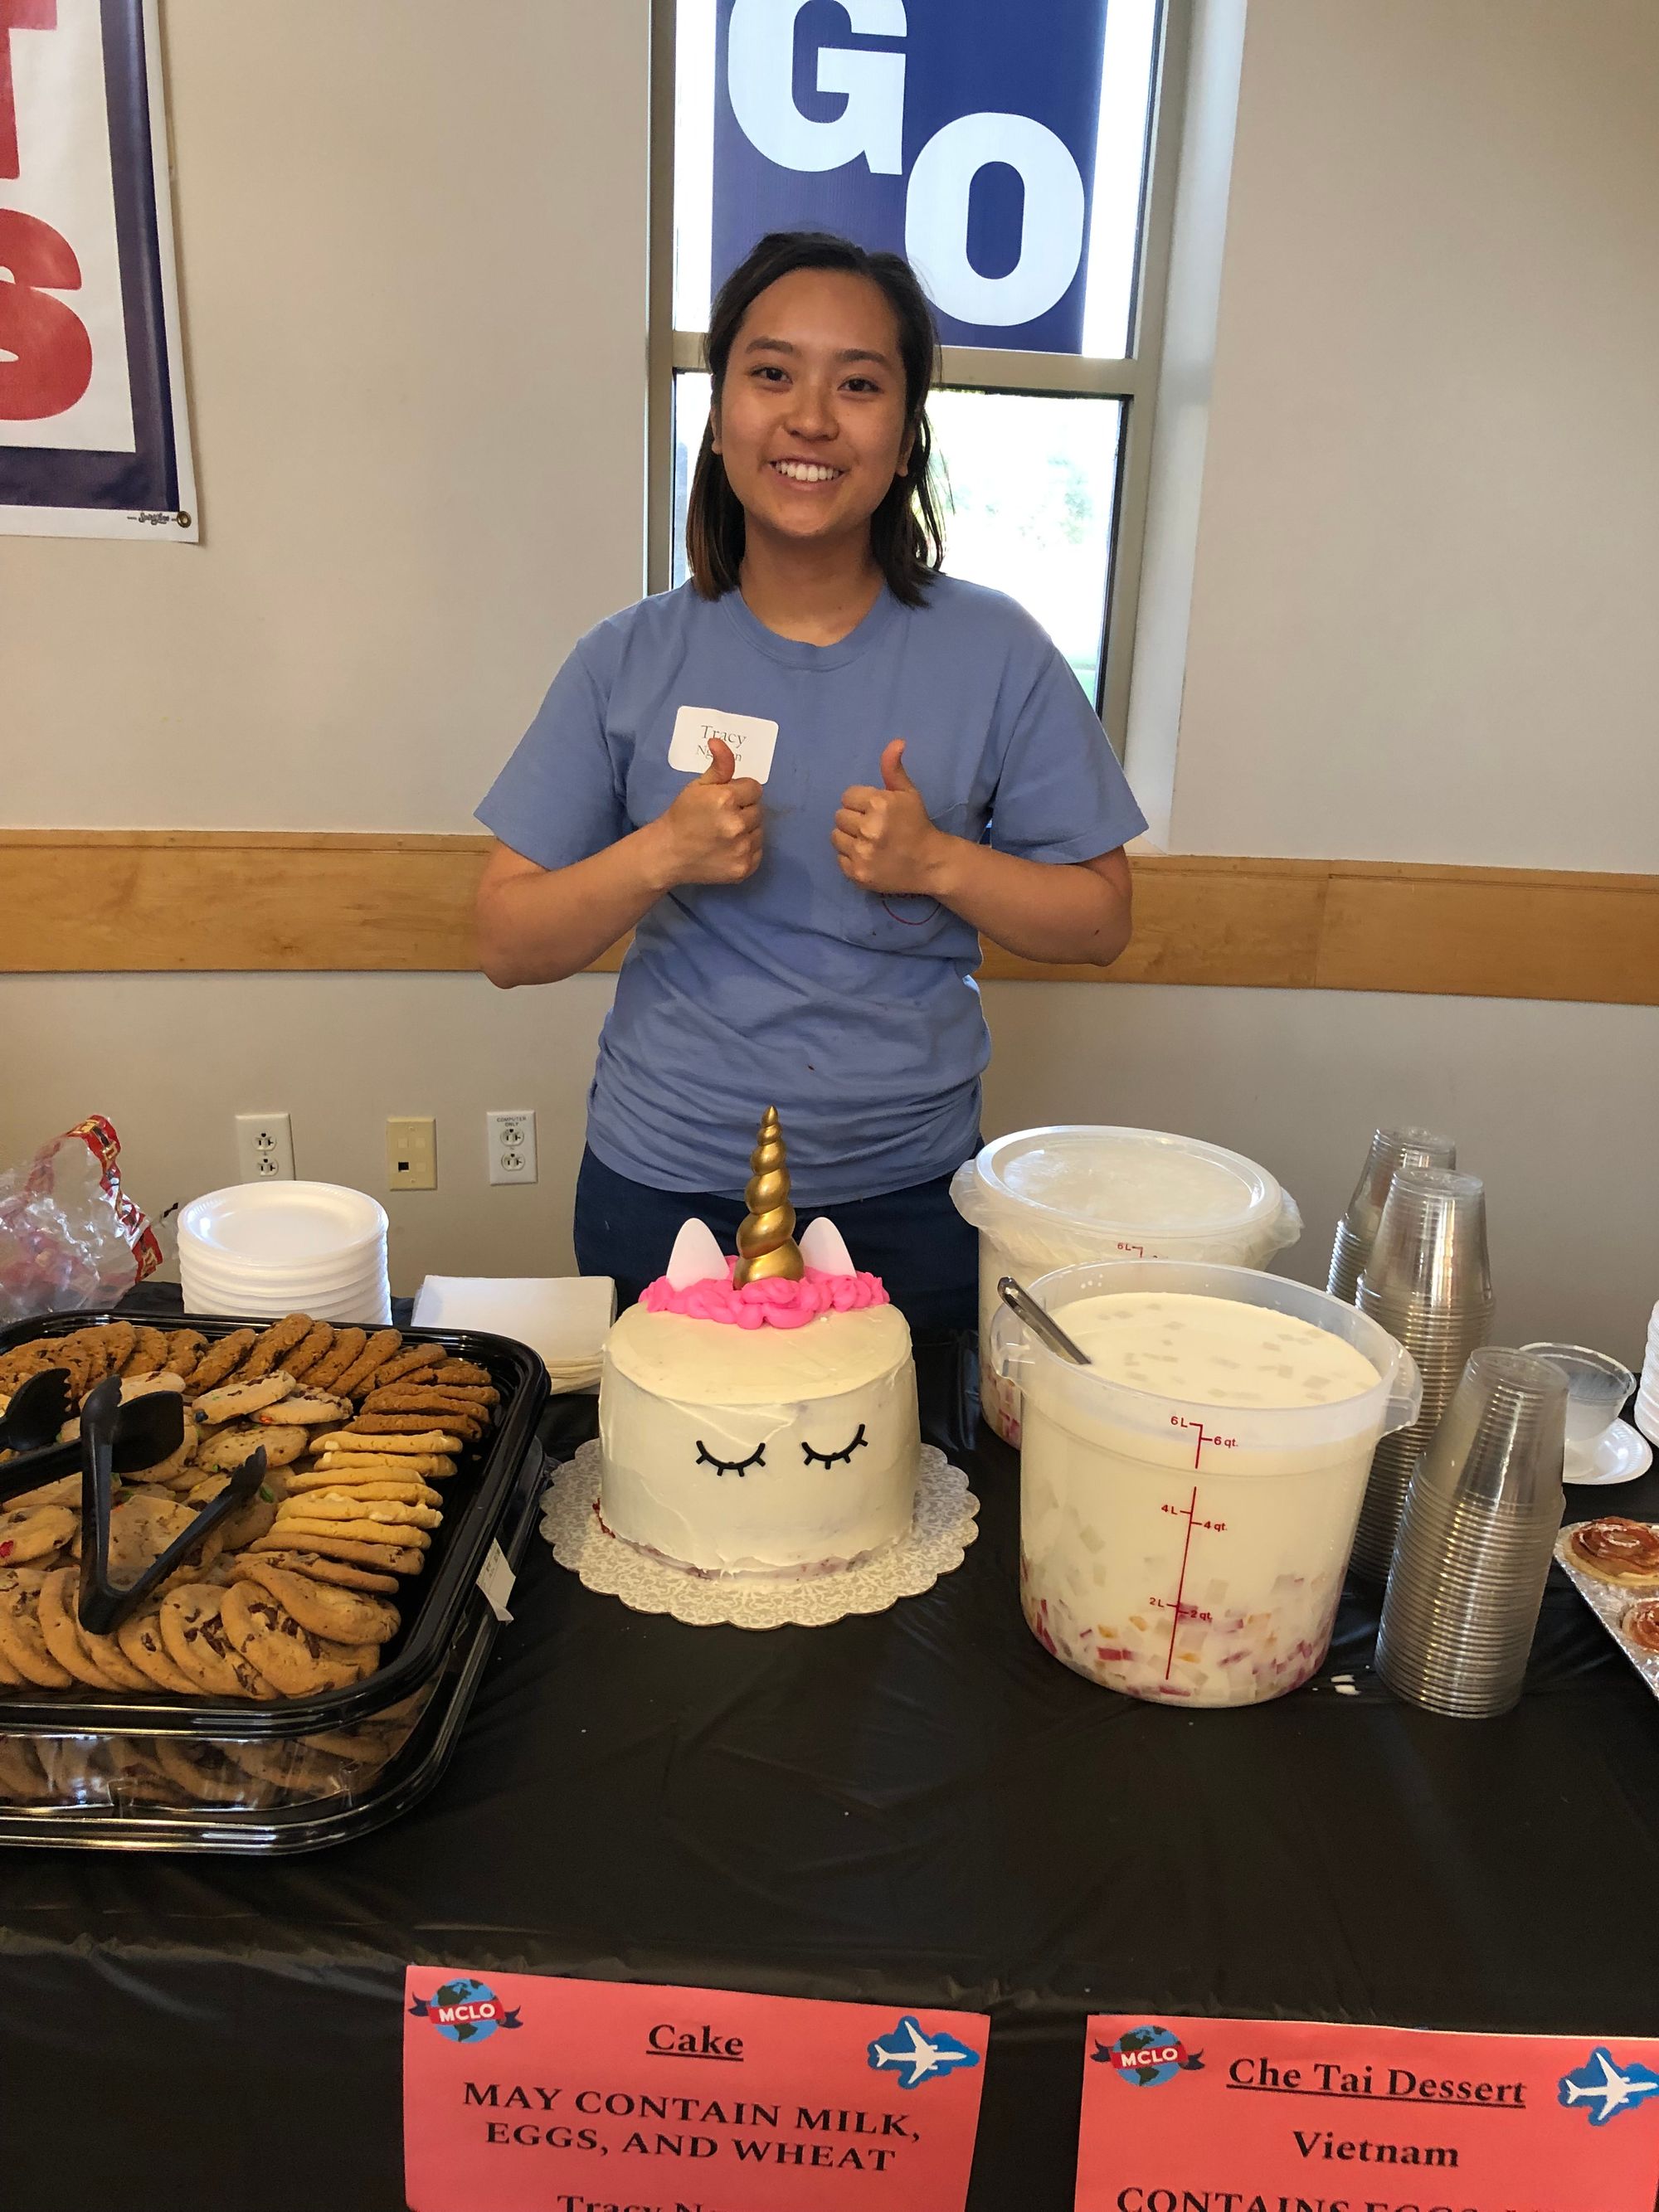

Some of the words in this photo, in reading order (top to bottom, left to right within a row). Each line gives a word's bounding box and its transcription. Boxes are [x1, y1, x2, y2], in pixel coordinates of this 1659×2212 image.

[701, 725, 747, 748] Tracy
[438, 2003, 496, 2023] MCLO
[648, 2024, 744, 2055] Cake
[1120, 2047, 1179, 2068] MCLO
[1228, 2056, 1301, 2089] Che
[1314, 2064, 1373, 2094] Tai
[1387, 2068, 1528, 2103] Dessert
[463, 2082, 562, 2111] MAY
[575, 2091, 782, 2127] CONTAIN
[795, 2107, 920, 2143] MILK,
[486, 2122, 608, 2156] EGGS,
[622, 2132, 718, 2158] AND
[731, 2138, 896, 2171] WHEAT
[1292, 2131, 1459, 2168] Vietnam
[557, 2195, 662, 2212] Tra
[1117, 2186, 1350, 2212] CONTAINS
